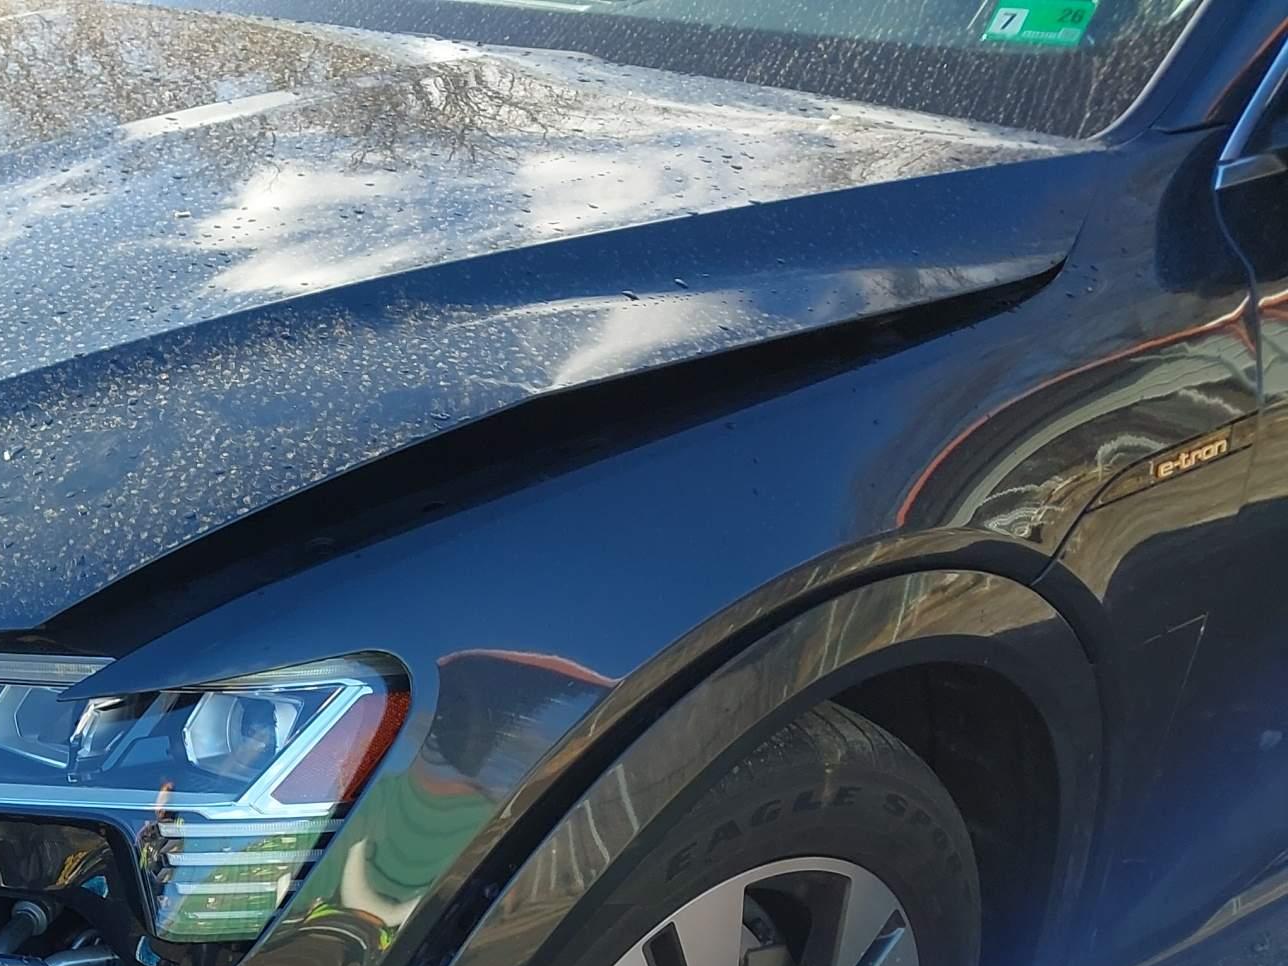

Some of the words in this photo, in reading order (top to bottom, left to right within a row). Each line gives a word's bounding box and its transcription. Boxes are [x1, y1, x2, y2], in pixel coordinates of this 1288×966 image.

[1000, 12, 1018, 31] 7
[1057, 8, 1086, 24] 26
[1157, 439, 1228, 478] e-tron
[665, 785, 863, 883] EAGLE
